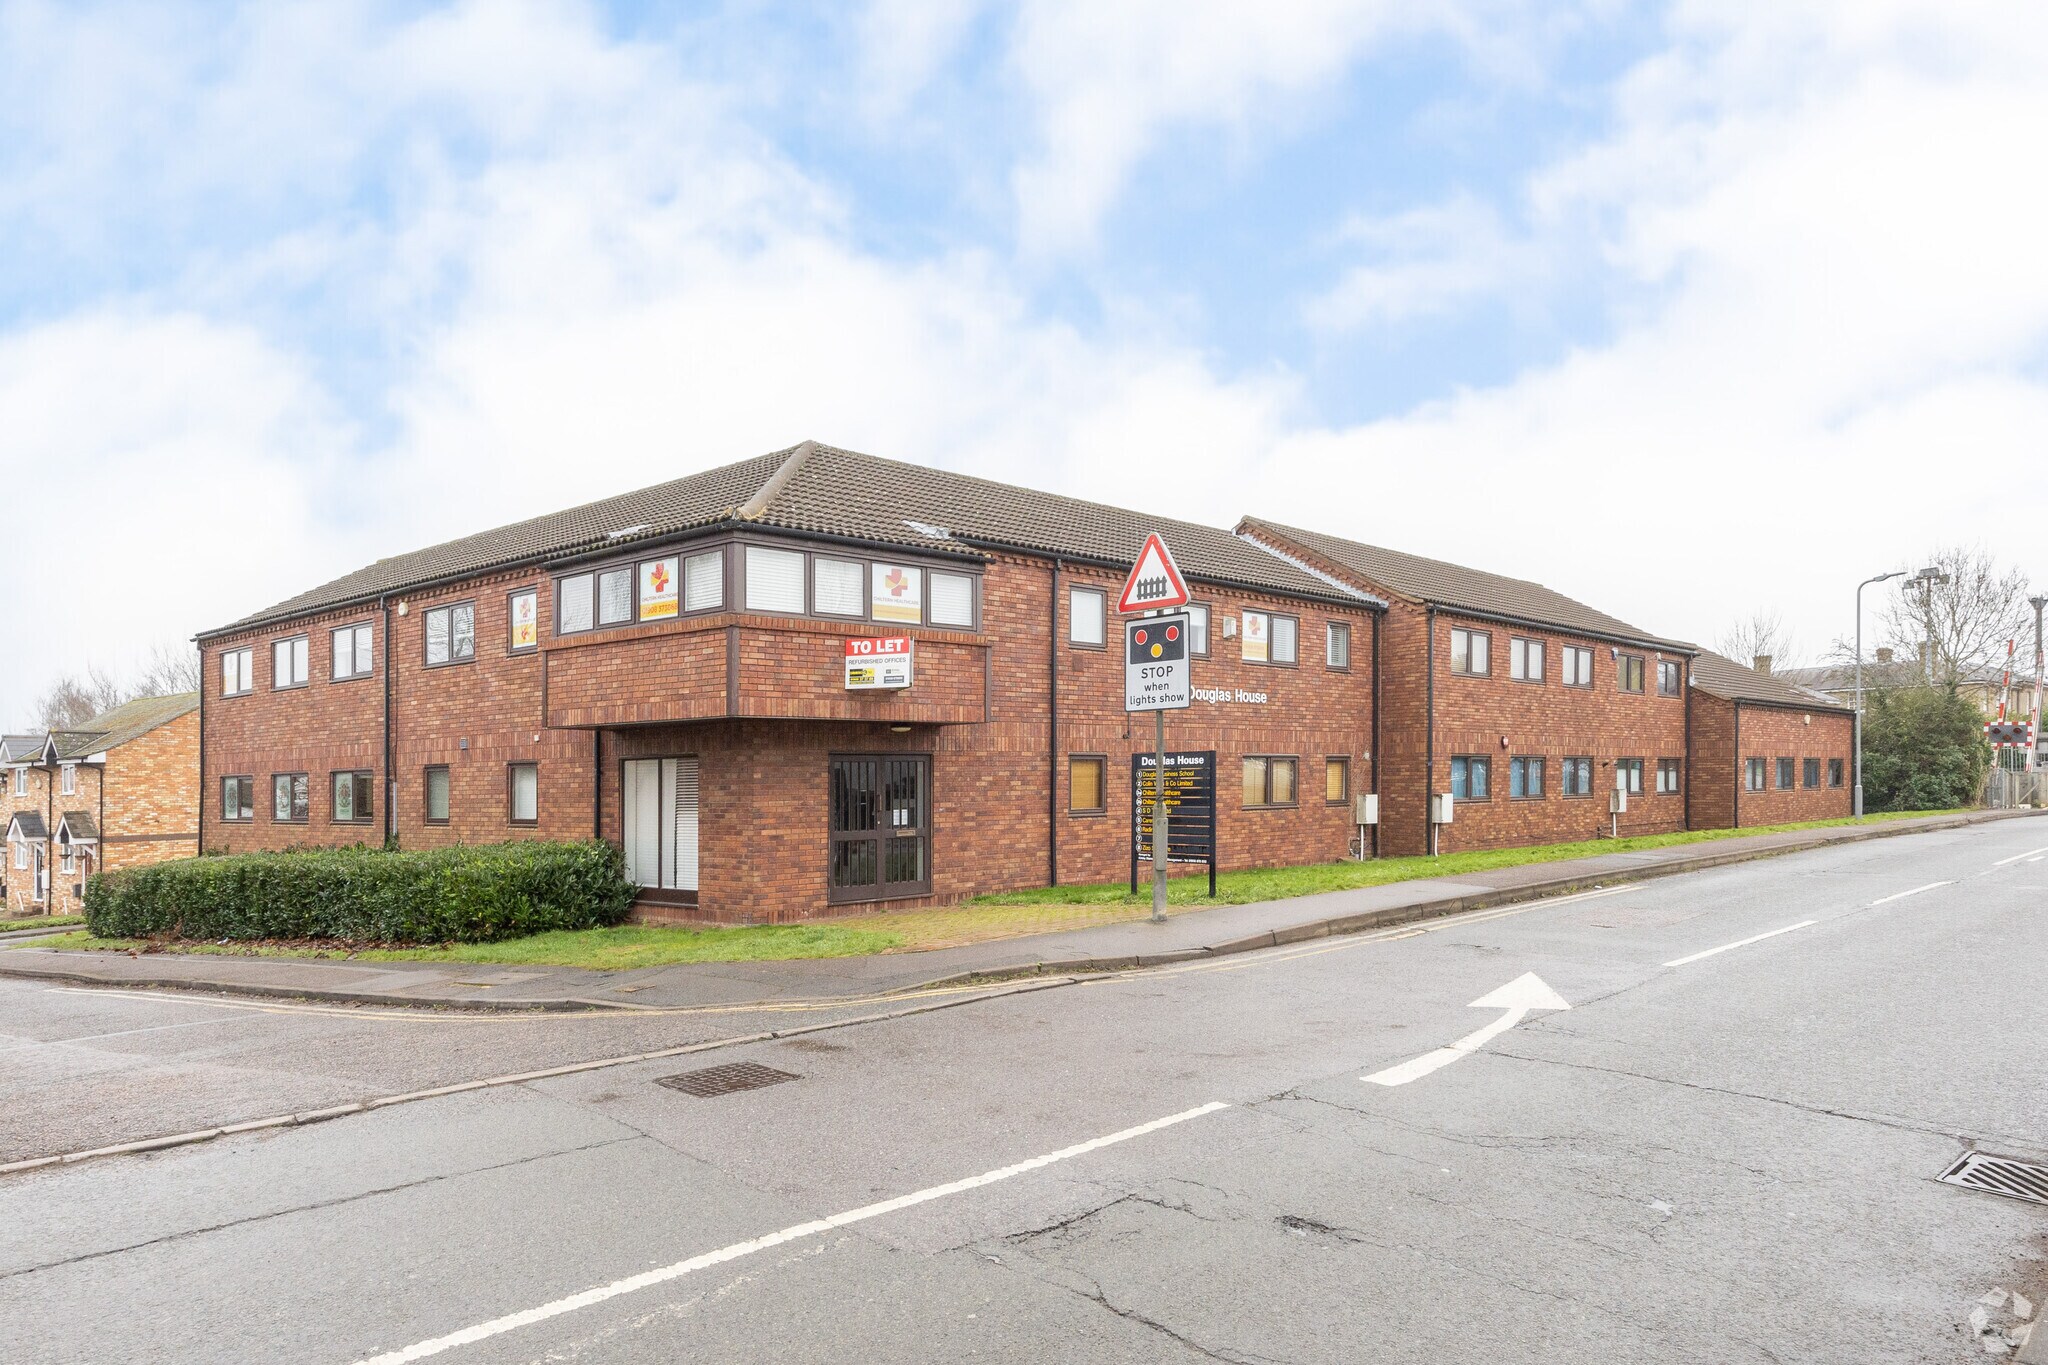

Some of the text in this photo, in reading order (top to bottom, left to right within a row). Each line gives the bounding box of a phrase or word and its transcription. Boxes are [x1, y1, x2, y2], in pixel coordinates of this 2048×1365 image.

[851, 639, 904, 654] TO LET
[1141, 666, 1174, 679] STOP
[1144, 682, 1169, 692] when
[1130, 692, 1185, 706] lights show
[1190, 685, 1267, 704] Douglas House
[1141, 755, 1204, 766] Doulas House
